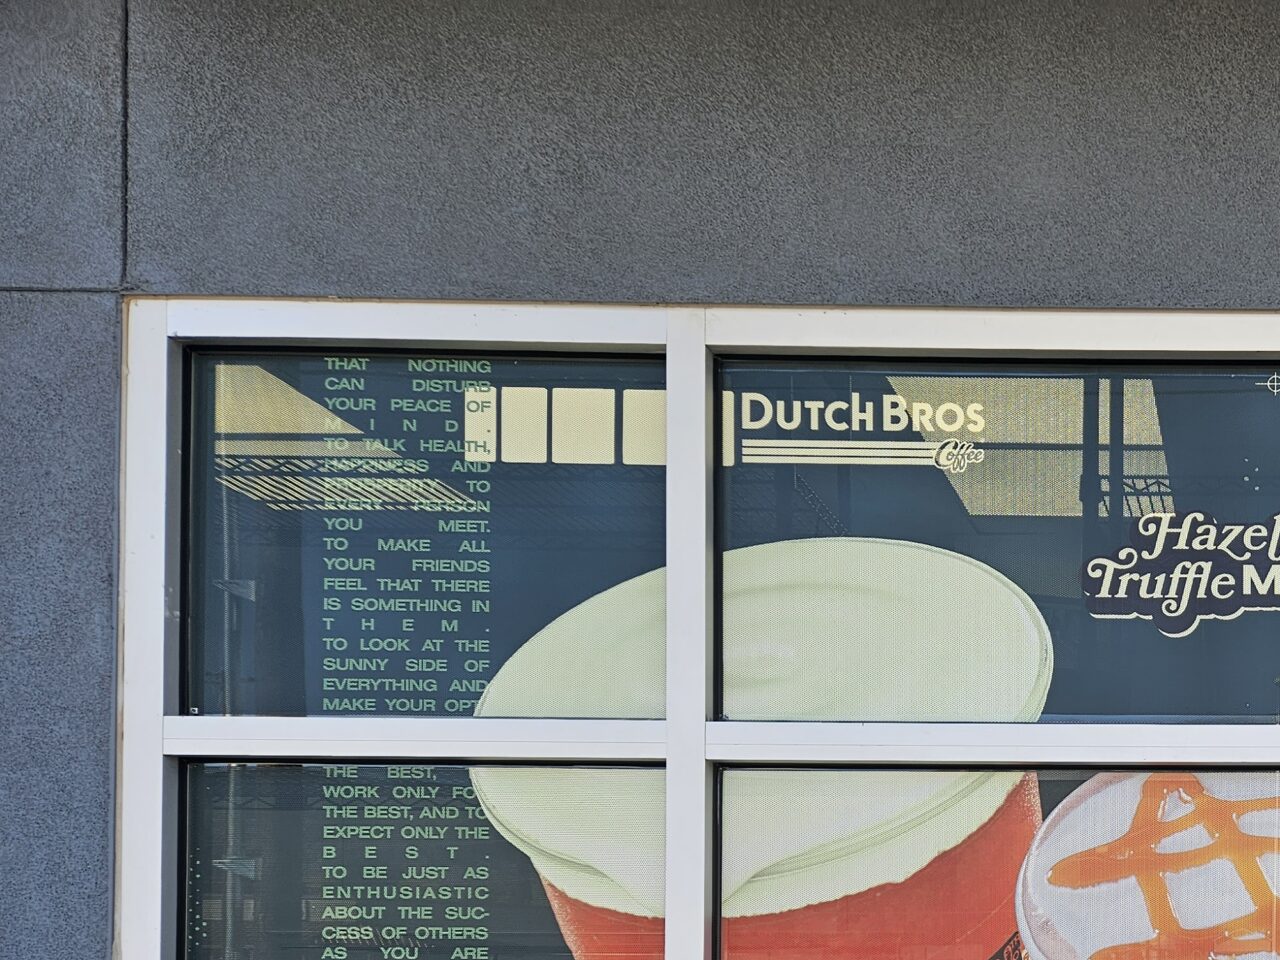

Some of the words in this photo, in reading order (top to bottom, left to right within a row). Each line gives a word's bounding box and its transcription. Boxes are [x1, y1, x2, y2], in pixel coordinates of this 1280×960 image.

[324, 357, 370, 371] THAT
[408, 358, 492, 373] NOTHING
[324, 377, 365, 391] CAN
[412, 379, 492, 393] DISTURB
[324, 397, 377, 412] YOUR
[390, 398, 452, 413] PEACE
[466, 399, 492, 414] OF
[741, 392, 874, 430] DUTCH
[882, 394, 985, 432] BROS
[324, 438, 349, 452] TO
[362, 438, 406, 452] TALK
[420, 439, 492, 455] HEALTH,
[935, 440, 984, 471] Coffee
[451, 460, 491, 473] AND
[466, 480, 491, 494] TO
[414, 499, 491, 513] PERSON
[324, 517, 363, 532] YOU
[438, 519, 491, 533] MEET.
[323, 537, 349, 552] TO
[377, 538, 431, 552] MAKE
[458, 539, 491, 553] ALL
[323, 557, 376, 572] YOUR
[412, 559, 491, 573] FRIENDS
[323, 578, 367, 592] FEEL
[377, 579, 422, 592] THAT
[431, 579, 491, 593] THERE
[1087, 547, 1235, 617] Truffle
[323, 597, 341, 612] IS
[351, 598, 462, 613] SOMETHING
[472, 599, 491, 613] IN
[322, 638, 348, 652] TO
[359, 638, 410, 653] LOOK
[421, 639, 447, 652] AT
[454, 639, 491, 653] THE
[322, 658, 389, 672] SUNNY
[405, 659, 448, 673] SIDE
[464, 659, 491, 673] OF
[322, 678, 438, 692] EVERYTHING
[449, 679, 488, 693] AND
[322, 698, 377, 712] MAKE
[384, 698, 436, 712] YOUR
[324, 766, 359, 779] THE
[387, 767, 437, 781] BEST,
[322, 785, 379, 799] WORK
[392, 785, 440, 800] ONLY
[452, 786, 475, 800] FO
[322, 805, 358, 819] THE
[363, 805, 414, 821] BEST,
[419, 806, 459, 819] AND
[465, 806, 487, 820] TO
[322, 825, 395, 839] EXPECT
[401, 825, 447, 839] ONLY
[454, 825, 490, 840] THE
[322, 865, 348, 880] TO
[362, 866, 388, 880] BE
[401, 866, 449, 880] JUST
[463, 866, 489, 880] AS
[322, 886, 489, 900] ENTHUSIASTIC
[322, 906, 386, 920] ABOUT
[397, 906, 433, 920] THE
[445, 906, 490, 920] SUC-
[322, 926, 373, 940] CESS
[381, 926, 407, 940] OF
[415, 926, 489, 940] OTHERS
[321, 946, 348, 960] AS
[380, 946, 419, 960] YOU
[451, 946, 489, 960] ARE
